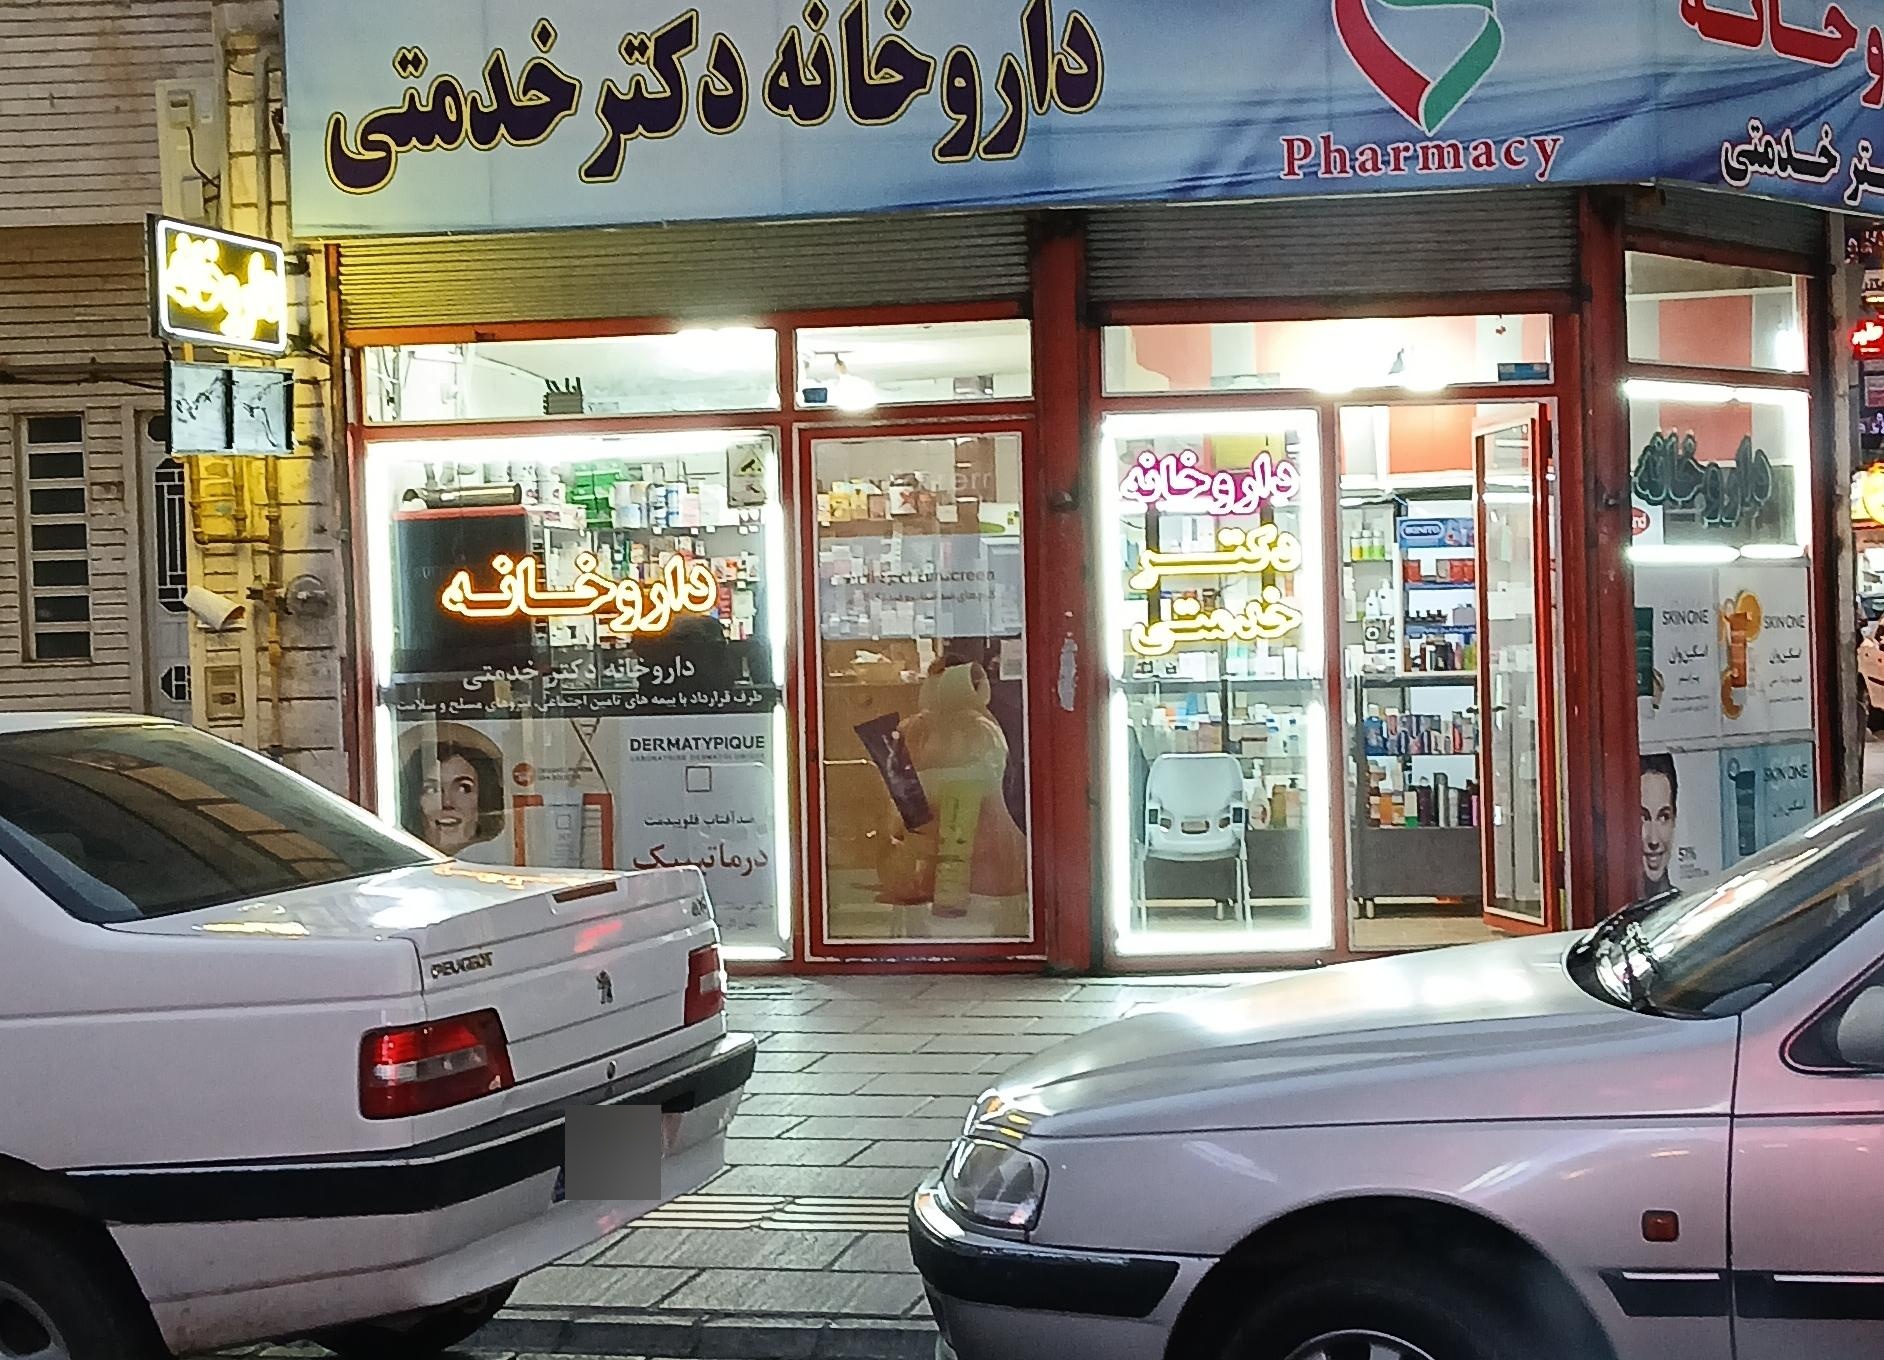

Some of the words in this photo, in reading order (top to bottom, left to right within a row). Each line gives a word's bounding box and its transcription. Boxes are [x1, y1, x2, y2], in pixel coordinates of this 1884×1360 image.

[325, 18, 583, 194] خدمتی
[578, 8, 748, 183] دکتر
[1280, 131, 1564, 182] Pharmacy
[1720, 117, 1841, 187] خدمتی
[1120, 448, 1300, 516] داروخانه
[1128, 522, 1301, 590] دکتر
[441, 551, 716, 633] داروخانه
[1129, 585, 1302, 656] خدمتی
[462, 659, 539, 691] خدمتی
[547, 658, 597, 688] دکتر
[602, 655, 696, 685] داروخانه
[689, 690, 731, 708] قرارداد
[630, 735, 765, 753] DERMATYPIQUE
